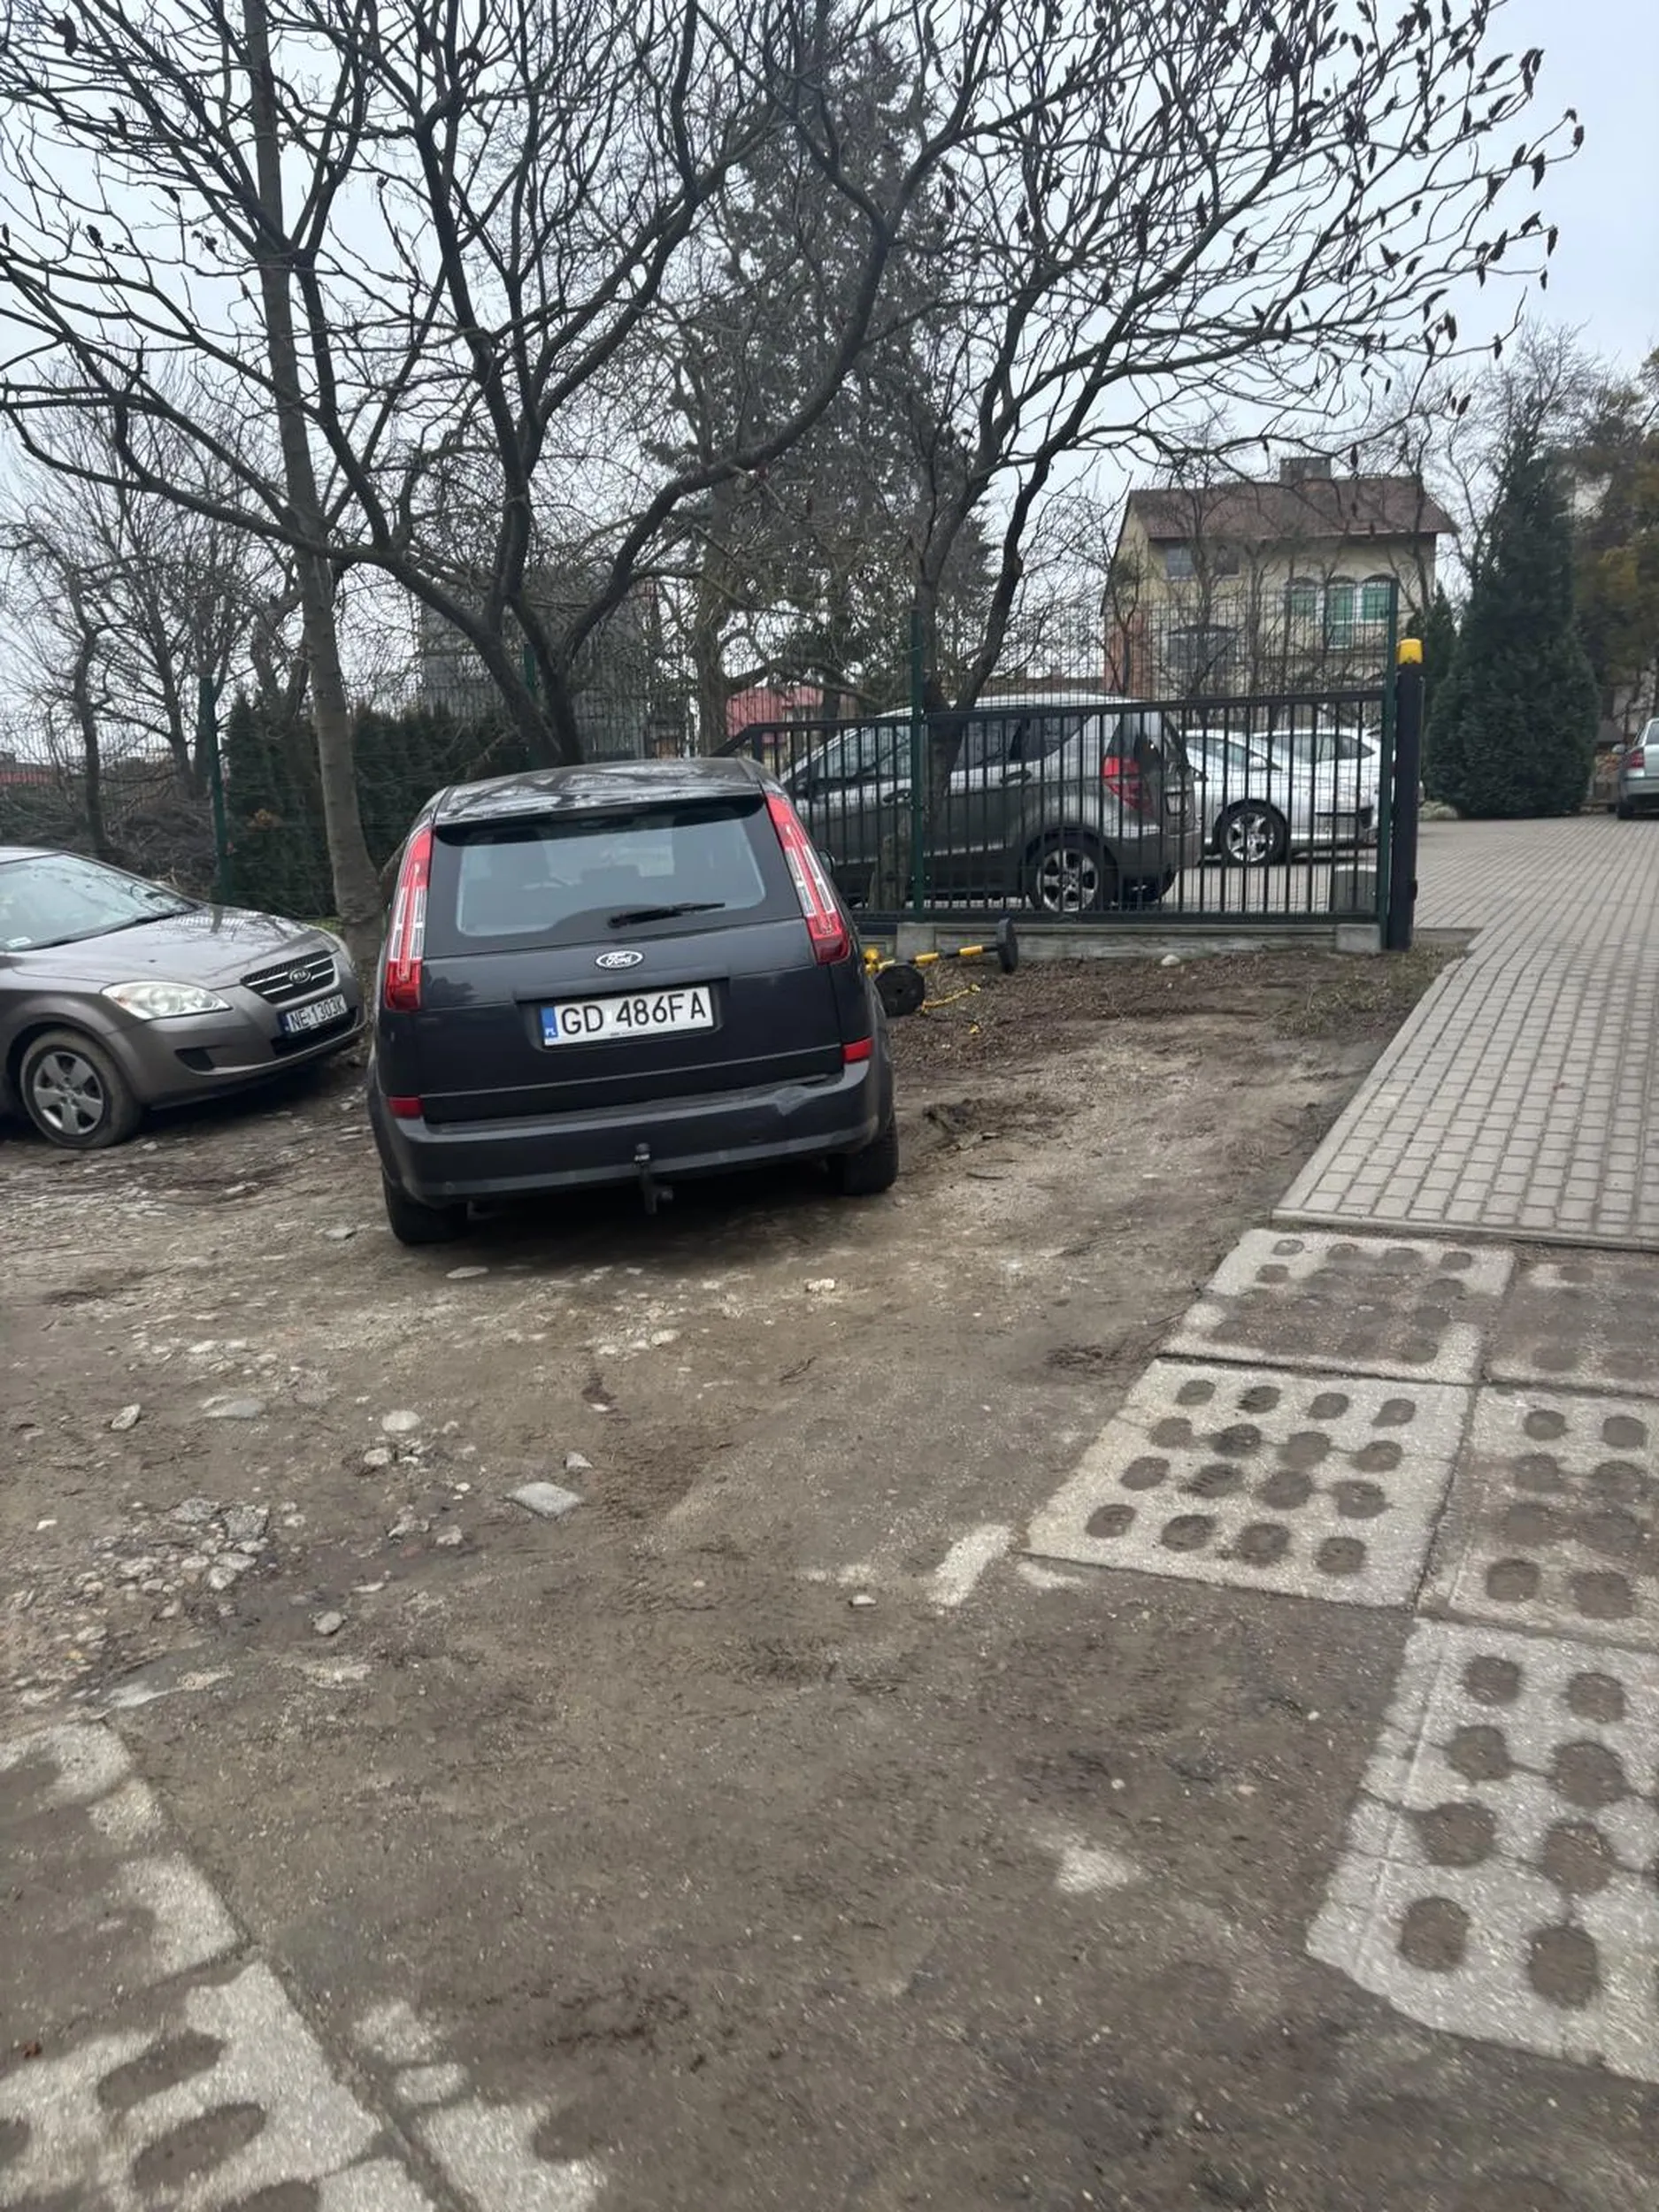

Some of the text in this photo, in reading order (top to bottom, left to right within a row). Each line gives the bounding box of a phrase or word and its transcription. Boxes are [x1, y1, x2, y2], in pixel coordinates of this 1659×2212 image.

[289, 1009, 310, 1030] NE
[561, 991, 707, 1035] GD 486FA
